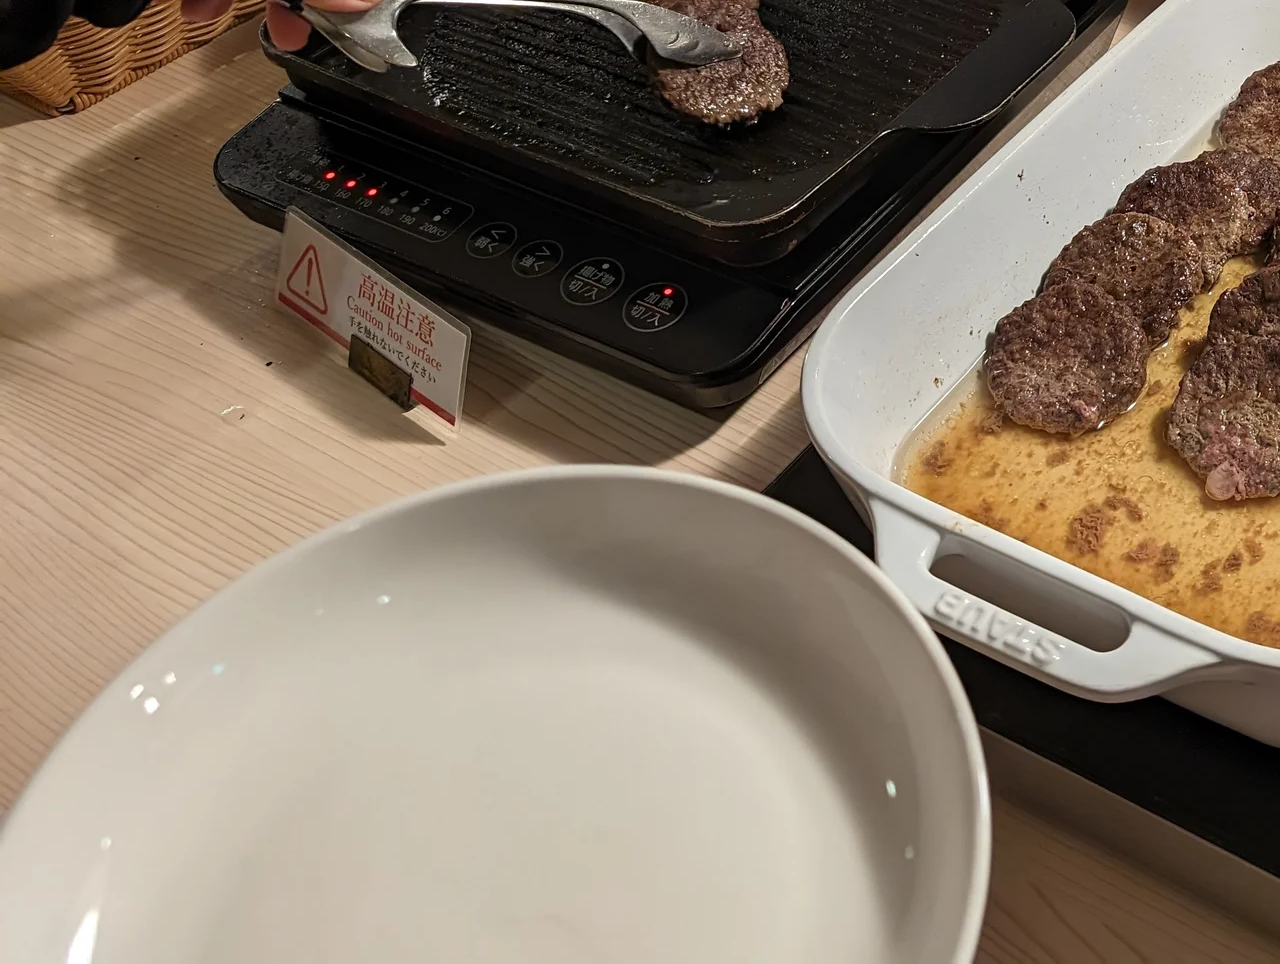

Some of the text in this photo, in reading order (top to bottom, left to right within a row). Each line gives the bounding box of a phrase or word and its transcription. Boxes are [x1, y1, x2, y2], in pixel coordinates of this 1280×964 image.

[334, 189, 351, 199] 160
[355, 197, 372, 207] 170
[377, 205, 394, 216] 180
[399, 214, 416, 225] 190
[400, 190, 409, 198] 4
[420, 198, 430, 206] 5
[442, 207, 451, 215] 6
[347, 295, 442, 372] Caution hot surface
[358, 273, 436, 347] 高温注意
[349, 315, 436, 384] 手を触れないでください
